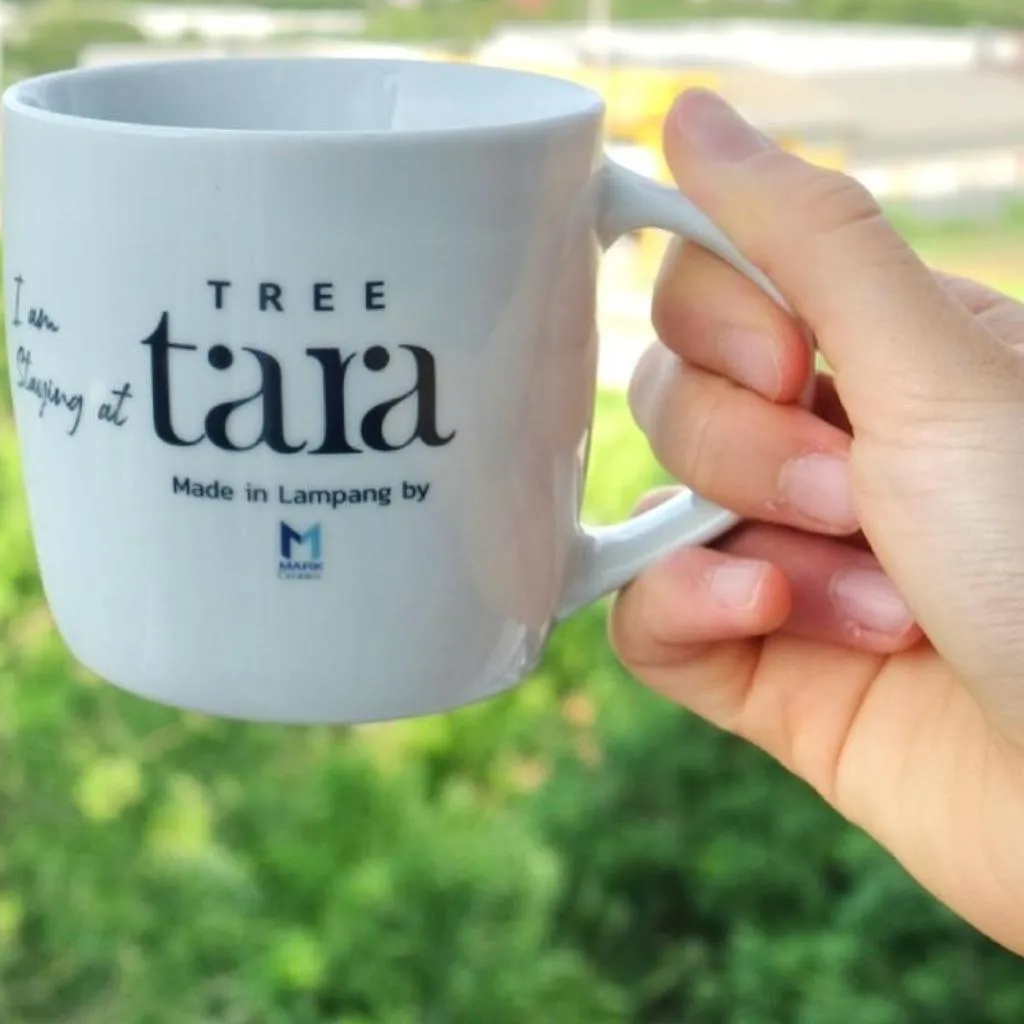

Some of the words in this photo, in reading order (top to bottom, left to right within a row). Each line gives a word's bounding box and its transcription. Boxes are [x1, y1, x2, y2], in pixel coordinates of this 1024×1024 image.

[206, 279, 387, 312] TREE
[140, 310, 456, 455] tara
[97, 382, 133, 427] at
[172, 476, 235, 502] Made
[245, 482, 269, 504] in
[278, 484, 392, 509] Lampang
[401, 479, 431, 503] by
